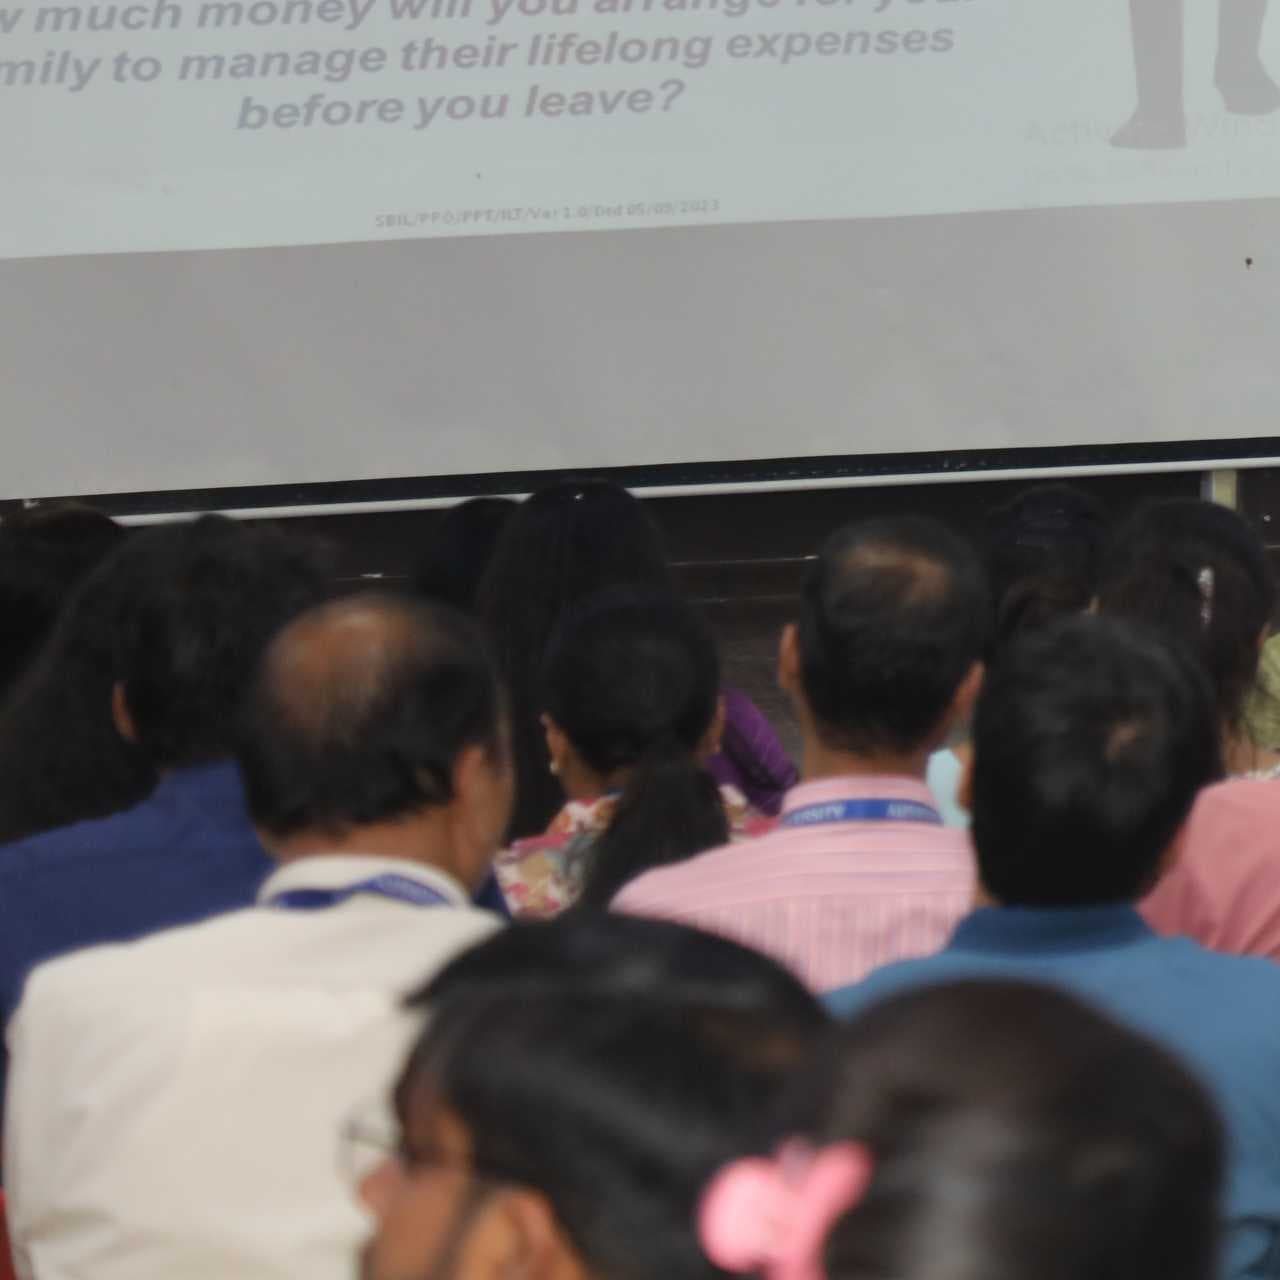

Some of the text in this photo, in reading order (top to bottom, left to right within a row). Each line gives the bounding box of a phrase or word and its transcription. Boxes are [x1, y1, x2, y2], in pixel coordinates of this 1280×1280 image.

[112, 50, 164, 84] to
[177, 46, 388, 83] manage
[401, 34, 519, 73] their
[527, 29, 715, 70] lifelong
[725, 26, 956, 65] expenses
[235, 76, 687, 132] before you leave?
